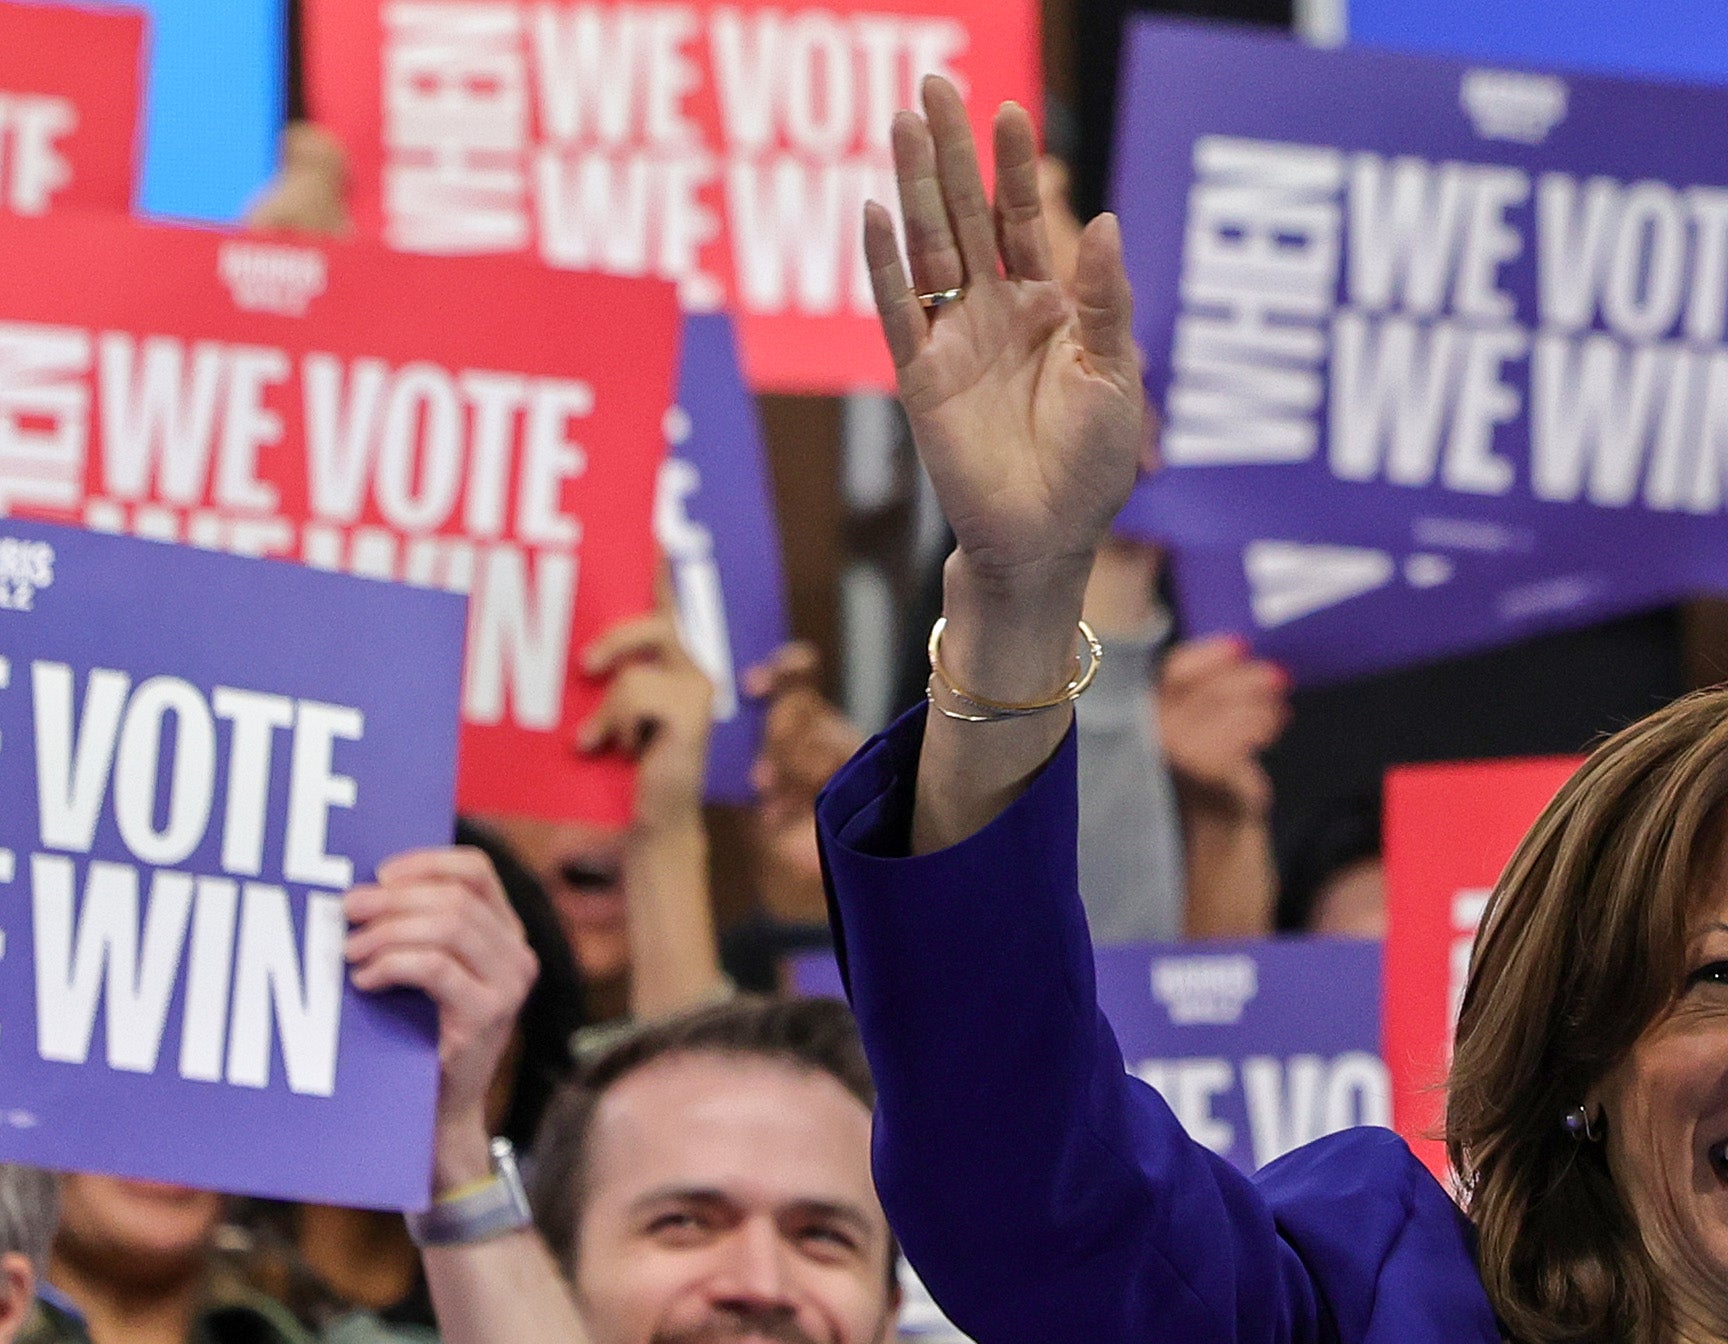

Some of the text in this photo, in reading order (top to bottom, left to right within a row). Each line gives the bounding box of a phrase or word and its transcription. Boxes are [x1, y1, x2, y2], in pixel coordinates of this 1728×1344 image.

[533, 5, 712, 142] WE
[537, 150, 726, 311] WE
[1162, 134, 1348, 468] WHEN
[1344, 150, 1530, 318] WE
[96, 330, 597, 547] WE VOTE
[1328, 312, 1530, 496] WE
[31, 659, 364, 890] VOTE
[31, 853, 348, 1098] WIN
